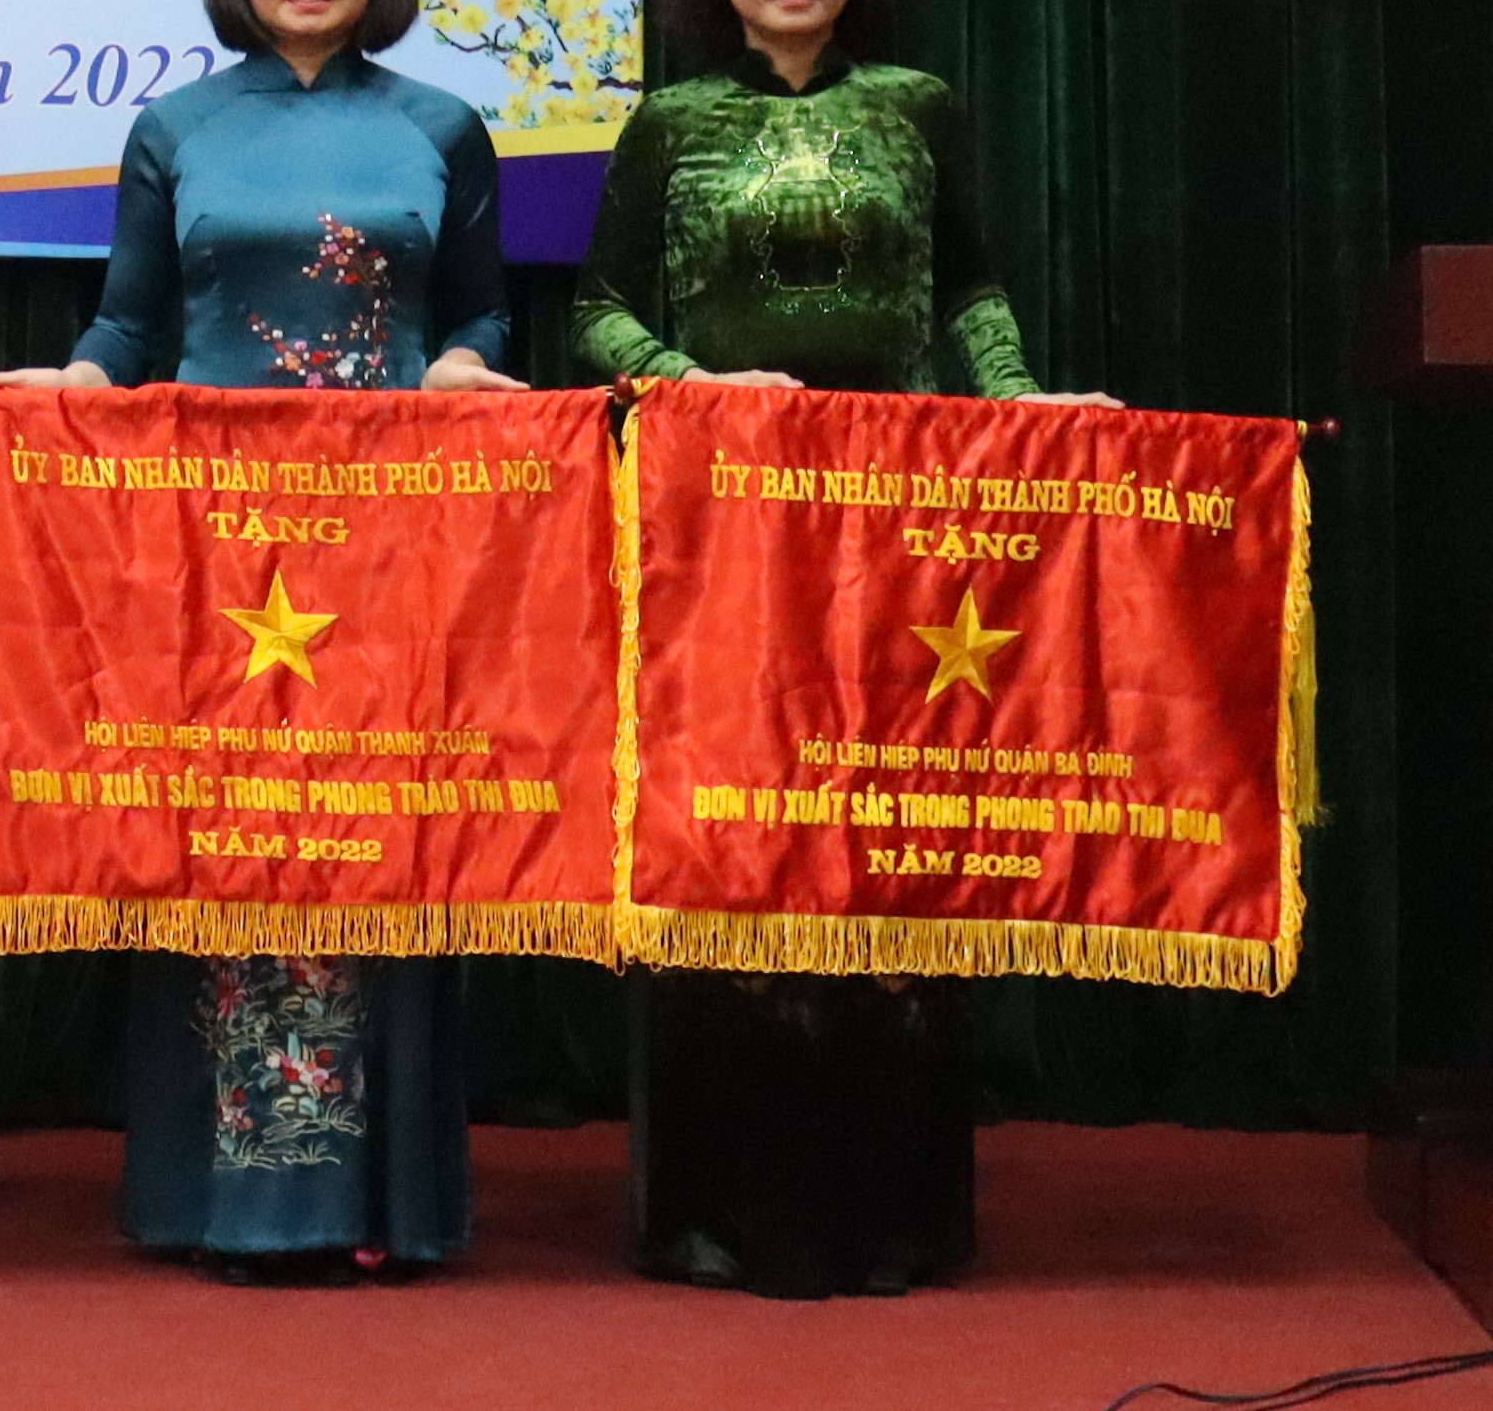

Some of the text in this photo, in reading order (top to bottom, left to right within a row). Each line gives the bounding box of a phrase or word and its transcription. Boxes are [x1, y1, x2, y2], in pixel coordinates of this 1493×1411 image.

[10, 436, 552, 502] ỦY BAN NHÂN DÂN THÀNH PHỐ HÀ NỘI
[710, 449, 1235, 535] ỦY BAN NHÂN DÂN THÀNH PHỐ HÀ NỘI
[207, 507, 350, 547] TẶNG
[903, 524, 1040, 565] TẶNG
[221, 776, 301, 813] TRONG
[308, 781, 393, 815] PHONG
[463, 779, 504, 812] THI
[508, 779, 560, 812] ĐUA
[898, 793, 970, 828] TRONG
[975, 795, 1056, 832] PHONG
[1127, 803, 1166, 838] THI
[1171, 808, 1221, 845] ĐUA
[189, 827, 382, 862] NĂM 2022
[868, 844, 1042, 878] NĂM 2022
